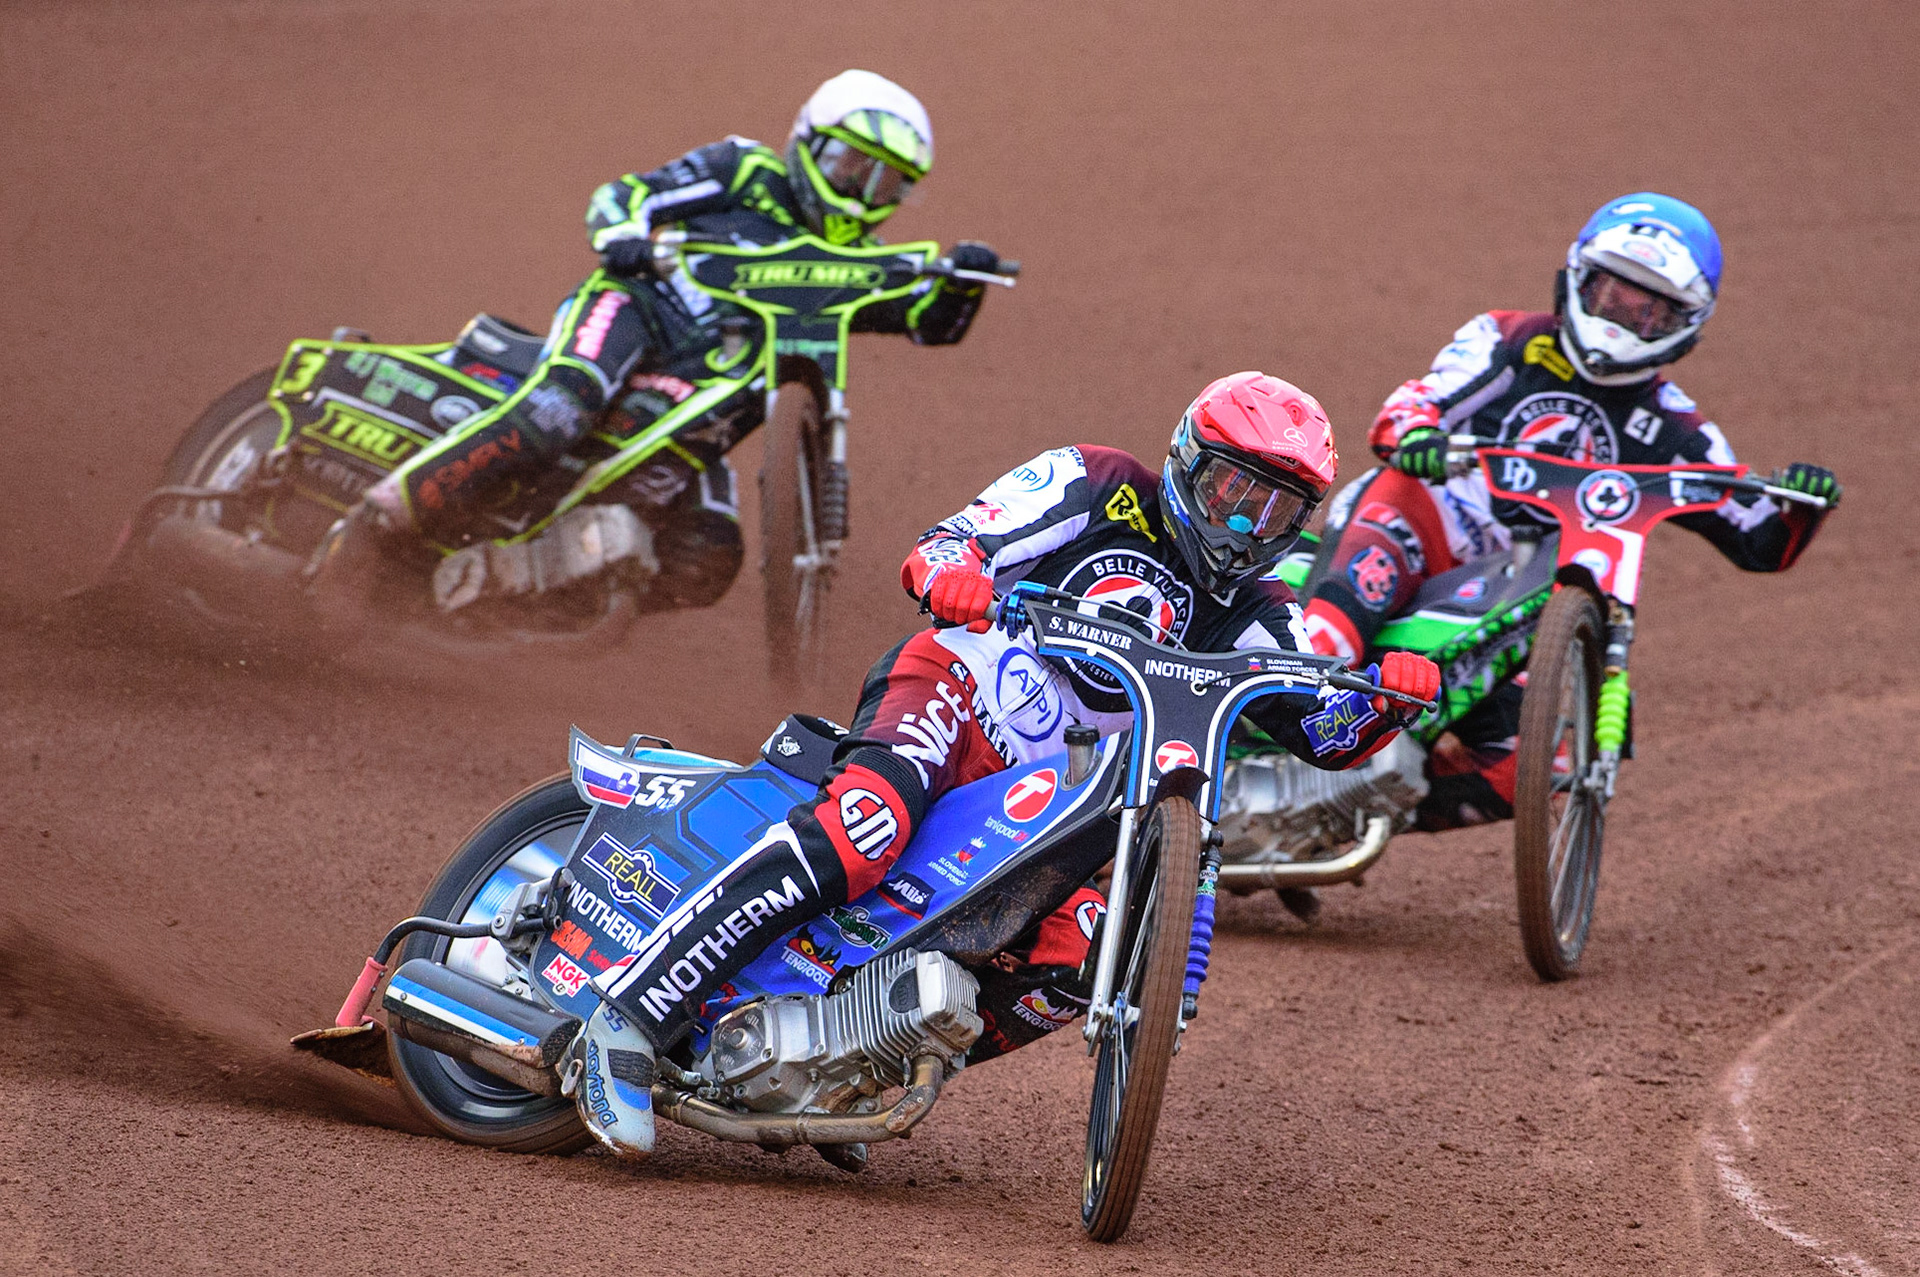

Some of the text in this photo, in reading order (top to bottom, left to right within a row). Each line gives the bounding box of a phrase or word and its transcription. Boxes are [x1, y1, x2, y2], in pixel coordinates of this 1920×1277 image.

[284, 351, 327, 394] 3
[1092, 558, 1147, 578] BELLE
[1048, 616, 1133, 650] S. WARNER
[1266, 658, 1304, 667] SLOVENIAN
[1292, 666, 1319, 674] FORCES
[1010, 669, 1051, 725] ATPI
[1314, 700, 1359, 742] REALL
[635, 775, 696, 808] 55
[603, 851, 657, 902] REALL
[639, 874, 805, 1023] INOTHERM
[550, 957, 588, 990] NGK
[587, 1039, 619, 1129] daytona
